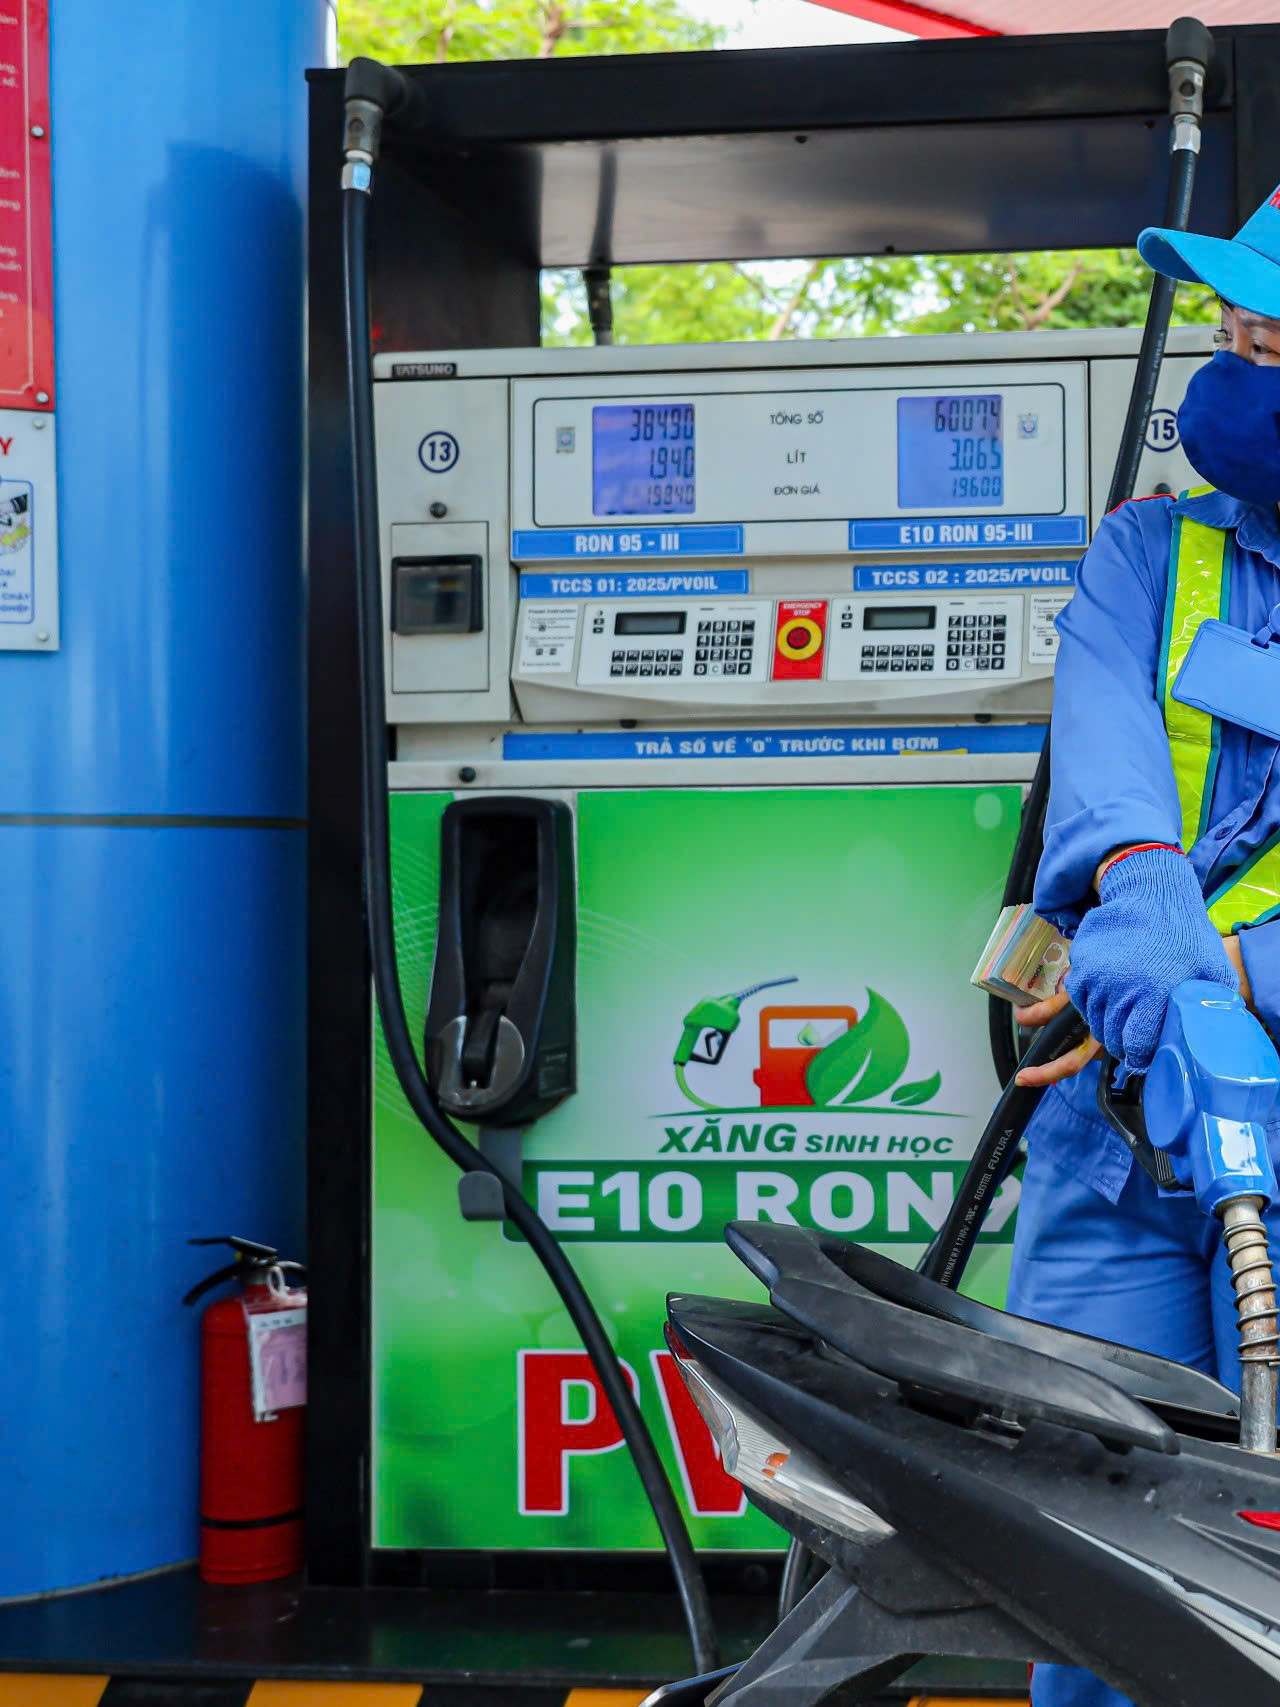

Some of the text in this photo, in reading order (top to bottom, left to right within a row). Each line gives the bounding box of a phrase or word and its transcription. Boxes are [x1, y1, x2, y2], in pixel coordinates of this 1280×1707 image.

[396, 363, 454, 377] TATSUNO
[629, 407, 695, 442] 38490
[769, 409, 825, 426] TỔNG SỐ
[935, 397, 1001, 433] 60074
[1150, 418, 1176, 441] 15
[428, 440, 452, 463] 13
[787, 448, 807, 465] LÍT
[800, 483, 820, 496] GIÁ
[575, 533, 614, 553] RON
[619, 533, 642, 552] 95
[661, 532, 680, 551] III
[900, 523, 1034, 544] E10 RON 95-III
[551, 575, 719, 594] TCCS 01: 2025/PVOIL
[872, 569, 920, 586] TCCS
[925, 569, 949, 585] 02
[965, 567, 1071, 584] 2025/PVOIL
[635, 735, 677, 755] TRẢ
[680, 736, 706, 754] SỐ
[780, 735, 845, 753] TRƯỚC
[851, 737, 886, 751] KHI
[892, 736, 940, 751] BƠM
[657, 1117, 955, 1158] XĂNG SINH HỌC
[974, 1172, 993, 1201] FLEXSTEEL
[988, 1128, 1014, 1171] FUTURA
[537, 1170, 704, 1233] E10
[735, 1170, 956, 1233] RON
